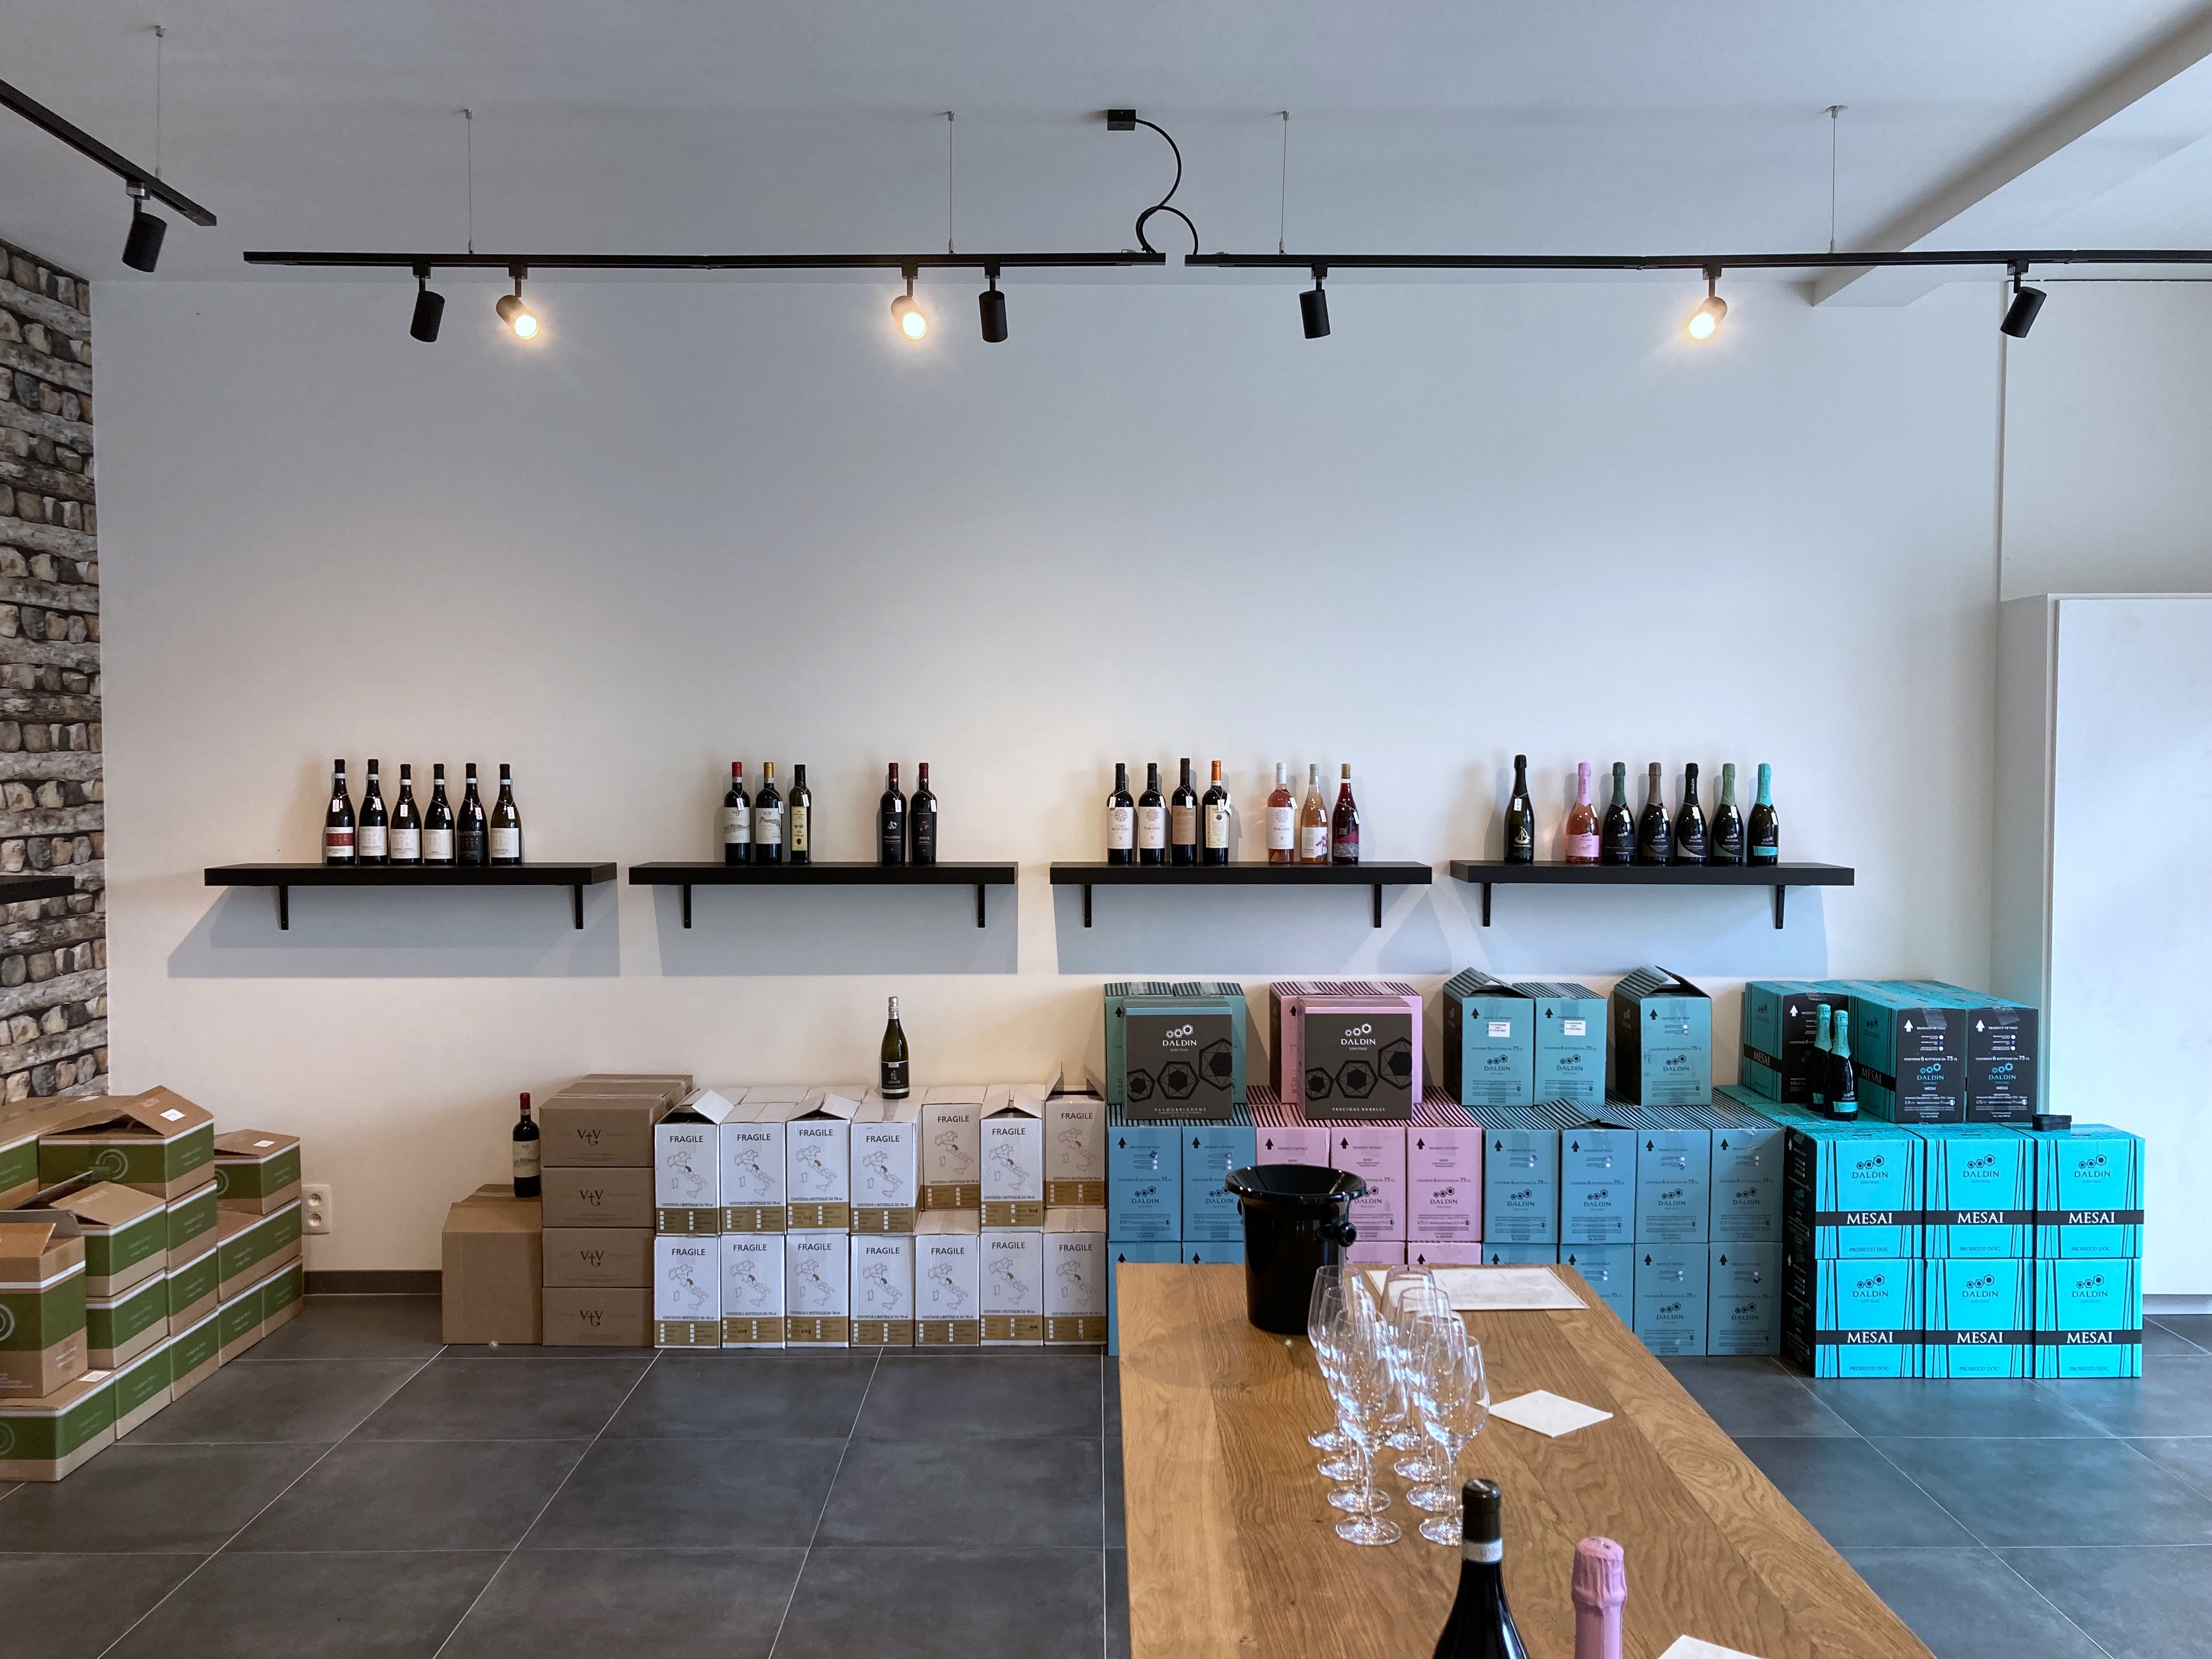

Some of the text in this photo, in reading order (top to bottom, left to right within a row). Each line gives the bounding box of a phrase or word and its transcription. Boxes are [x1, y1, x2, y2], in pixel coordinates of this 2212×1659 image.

[1753, 1051, 1770, 1066] MESAI
[1861, 1068, 1881, 1084] MESAI
[1847, 1212, 1893, 1224] MESAI
[1957, 1212, 2005, 1223] MESAI
[2068, 1212, 2115, 1223] MESAI
[1847, 1331, 1893, 1344] MESAI
[1956, 1332, 2004, 1344] MESAI
[2067, 1332, 2113, 1344] MESAI
